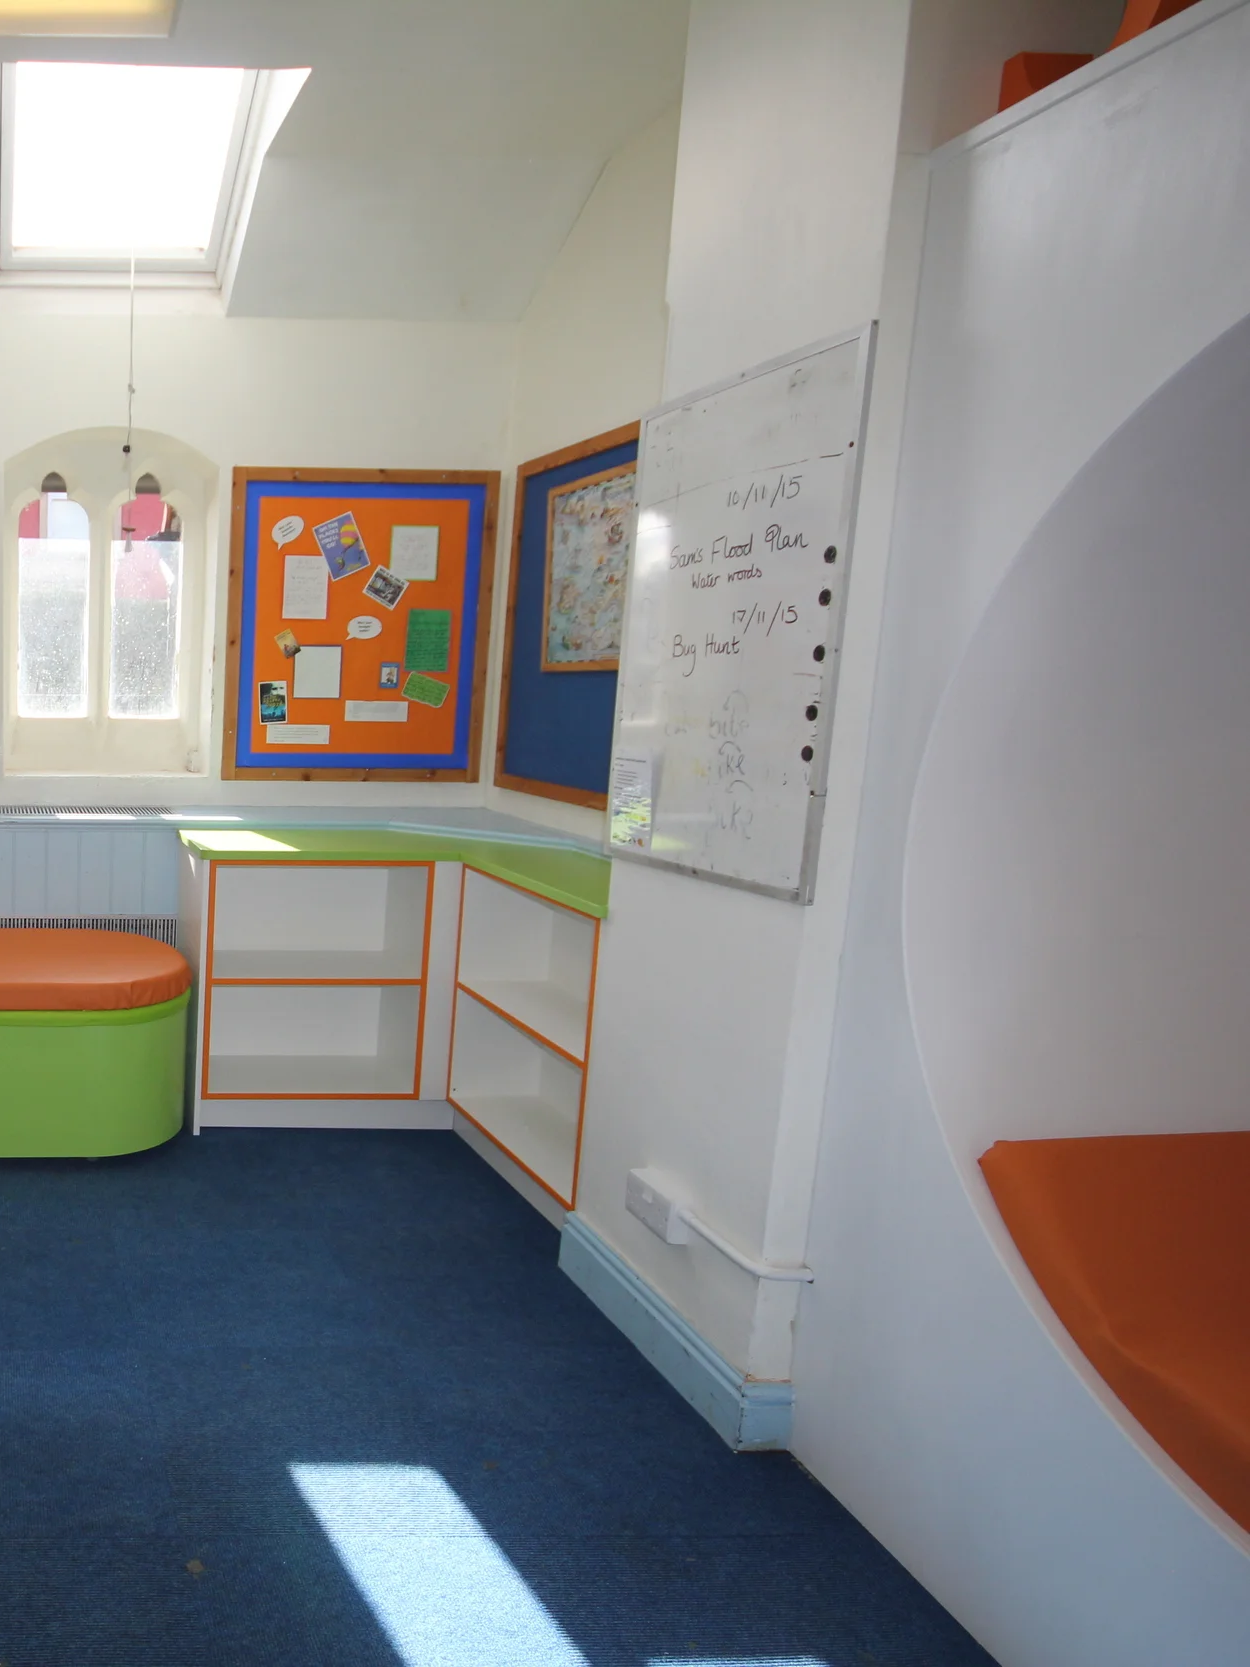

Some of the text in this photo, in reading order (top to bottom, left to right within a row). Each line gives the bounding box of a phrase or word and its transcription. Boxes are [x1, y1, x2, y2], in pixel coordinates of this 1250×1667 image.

[726, 474, 803, 511] 10/11/15
[670, 523, 809, 570] Sam's Flood Plan
[691, 563, 763, 589] Water words
[732, 601, 799, 637] 17/11/15
[672, 633, 740, 678] Bug Hunt
